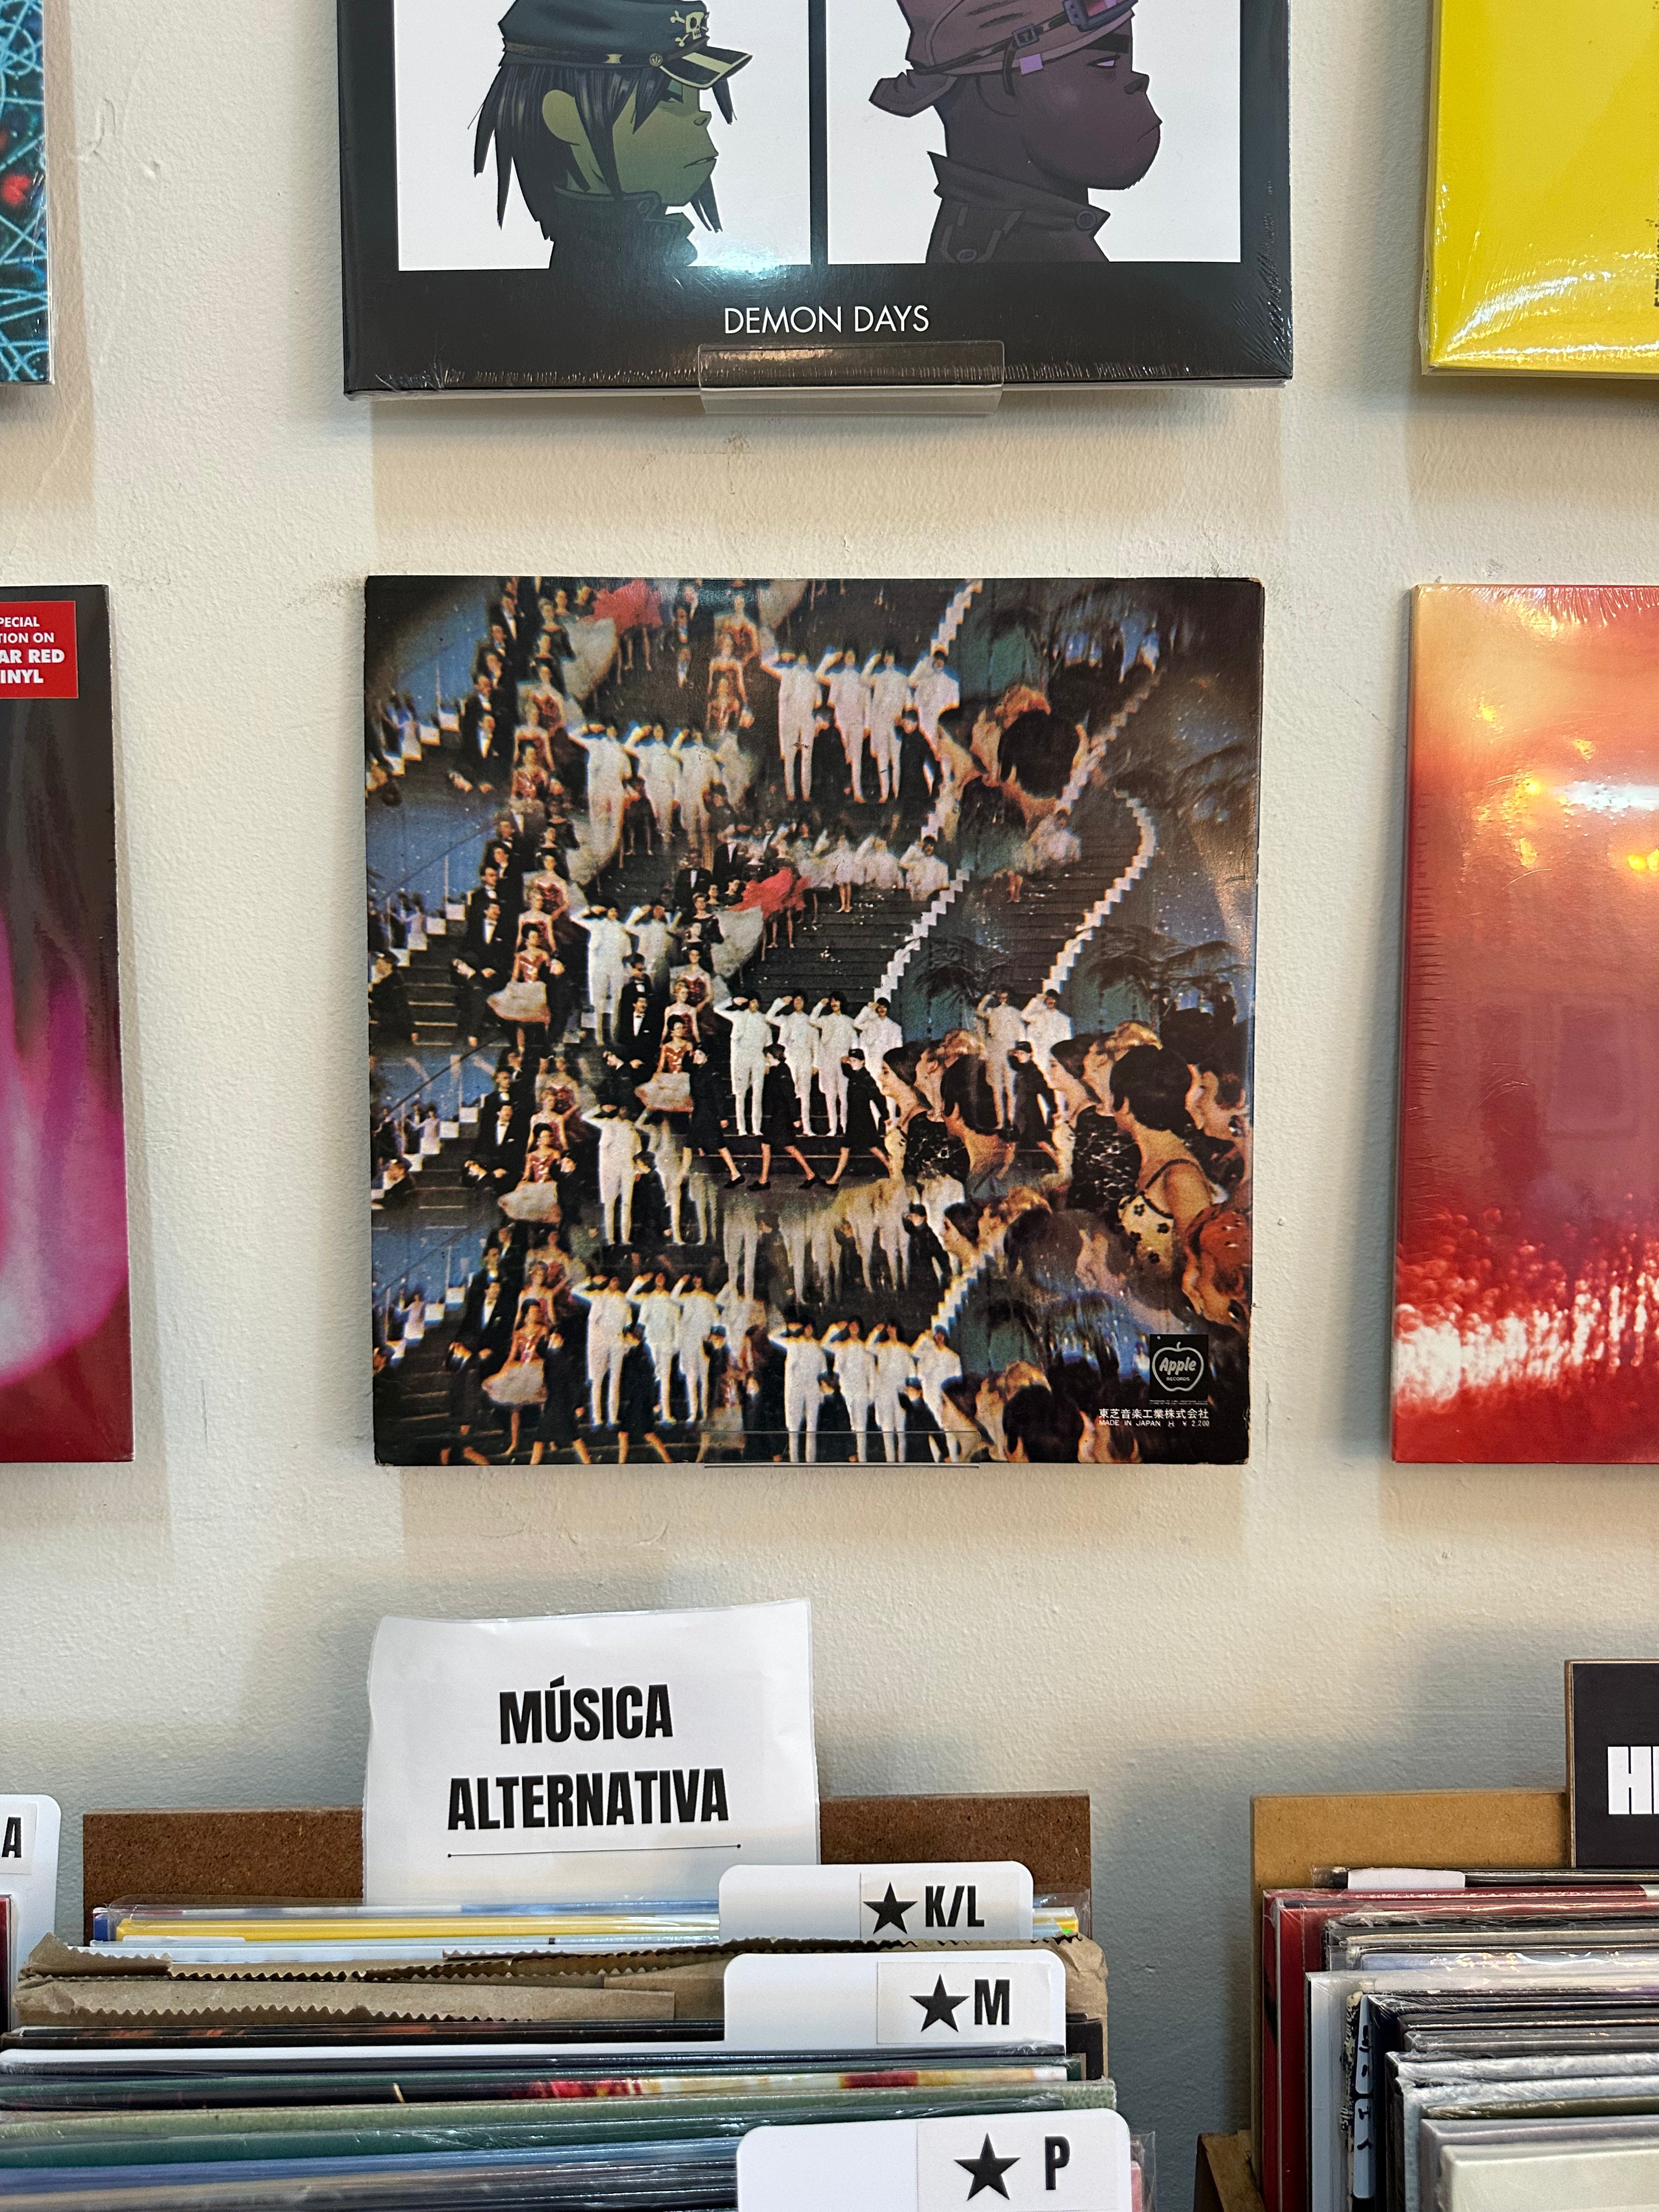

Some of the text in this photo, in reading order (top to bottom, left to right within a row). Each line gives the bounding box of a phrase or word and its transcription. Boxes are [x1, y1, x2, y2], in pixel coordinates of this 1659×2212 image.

[725, 305, 929, 334] DEMON DAYS
[28, 649, 65, 663] RED
[32, 633, 54, 643] ON
[1159, 1356, 1197, 1375] Apple
[1098, 1408, 1209, 1419] 東芝音楽工業株式会社
[499, 1675, 673, 1745] MÚSICA
[448, 1768, 729, 1830] ALTERNATIVA
[1607, 1746, 1659, 1815] H
[1, 1816, 22, 1858] A
[925, 1886, 985, 1928] K/L
[974, 1979, 1010, 2025] M
[1045, 2136, 1071, 2191] P
